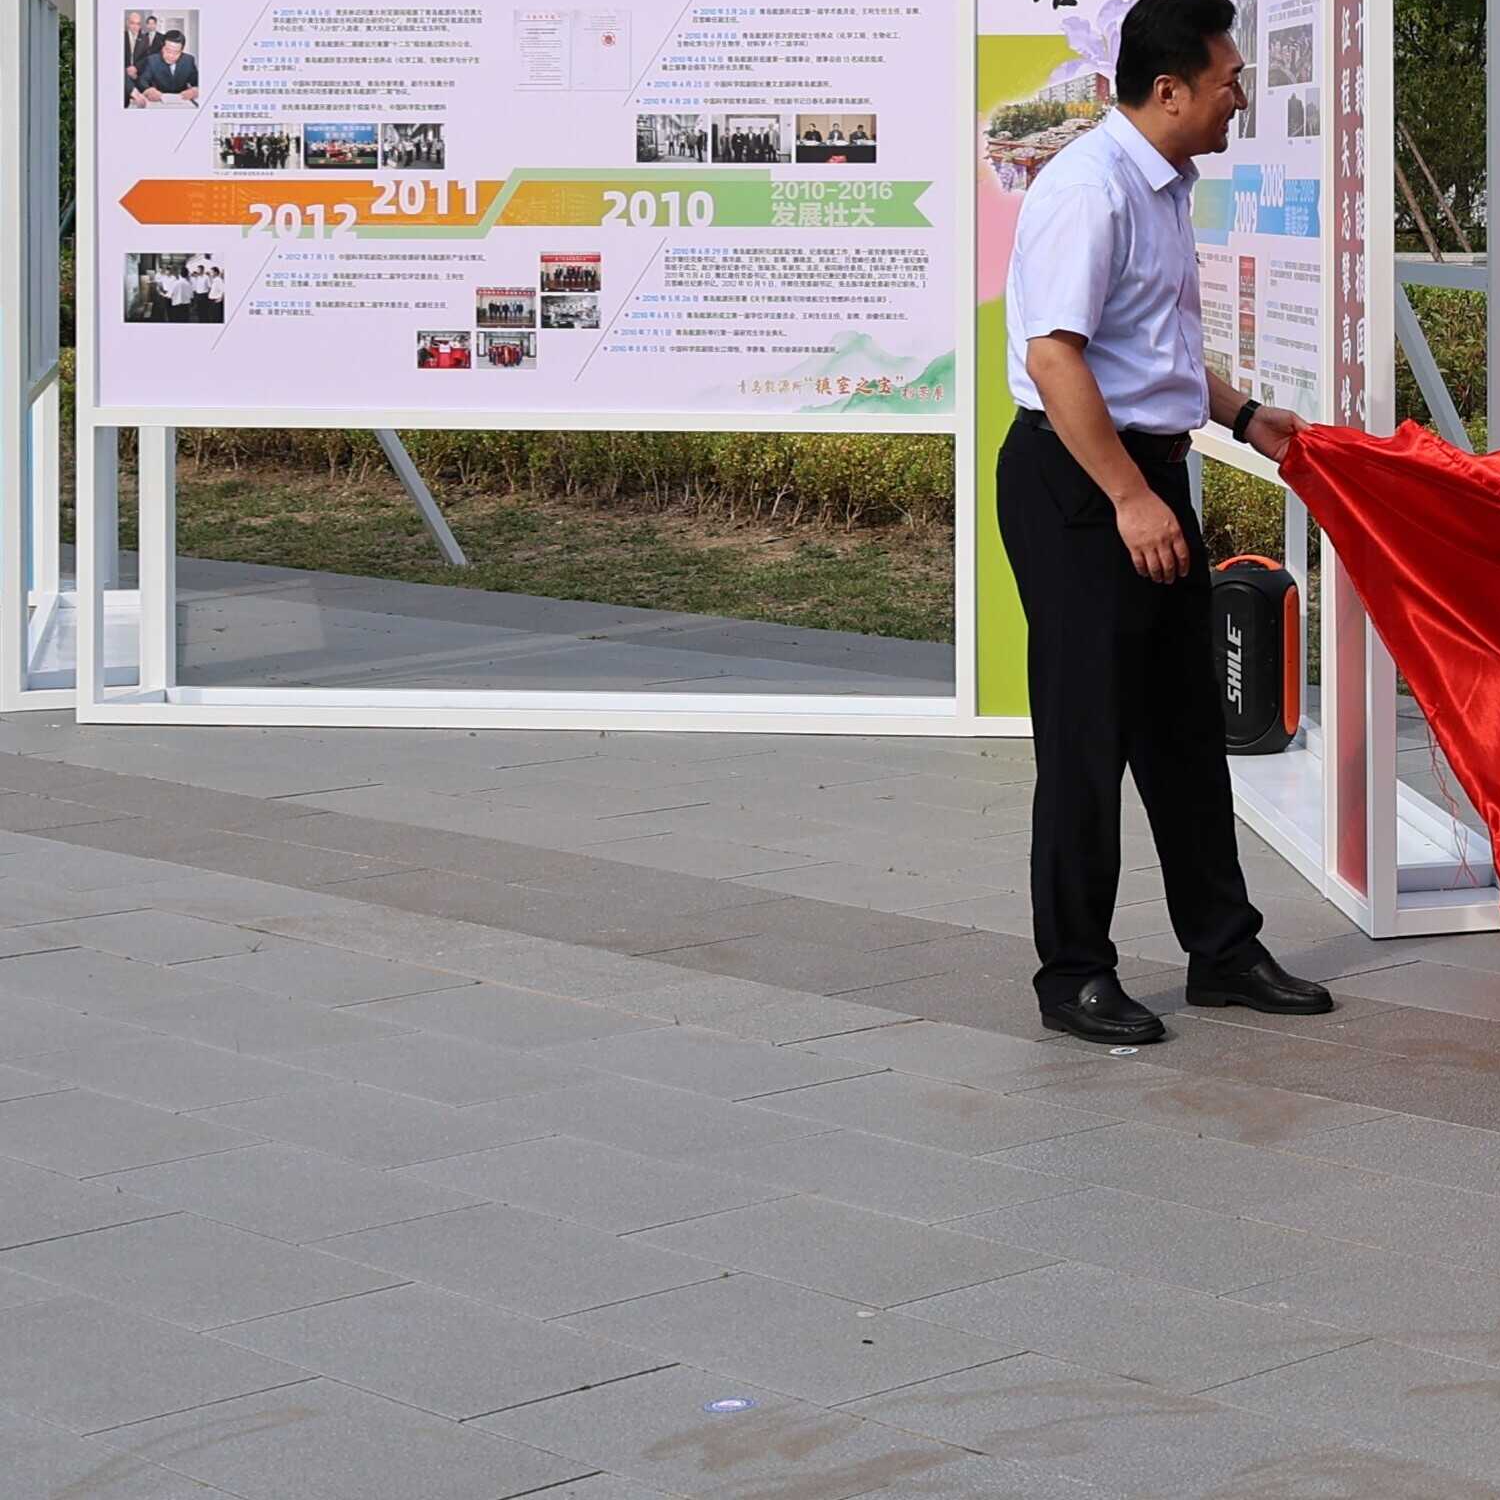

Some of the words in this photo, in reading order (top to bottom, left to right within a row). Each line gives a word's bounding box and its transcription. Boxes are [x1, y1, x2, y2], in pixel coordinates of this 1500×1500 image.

[371, 180, 478, 214] 2011
[771, 181, 892, 200] 2010-2016
[1260, 164, 1284, 207] 2008
[248, 204, 357, 238] 2012
[601, 191, 714, 227] 2010
[771, 202, 875, 227] 发展壮大
[1234, 190, 1257, 232] 2009
